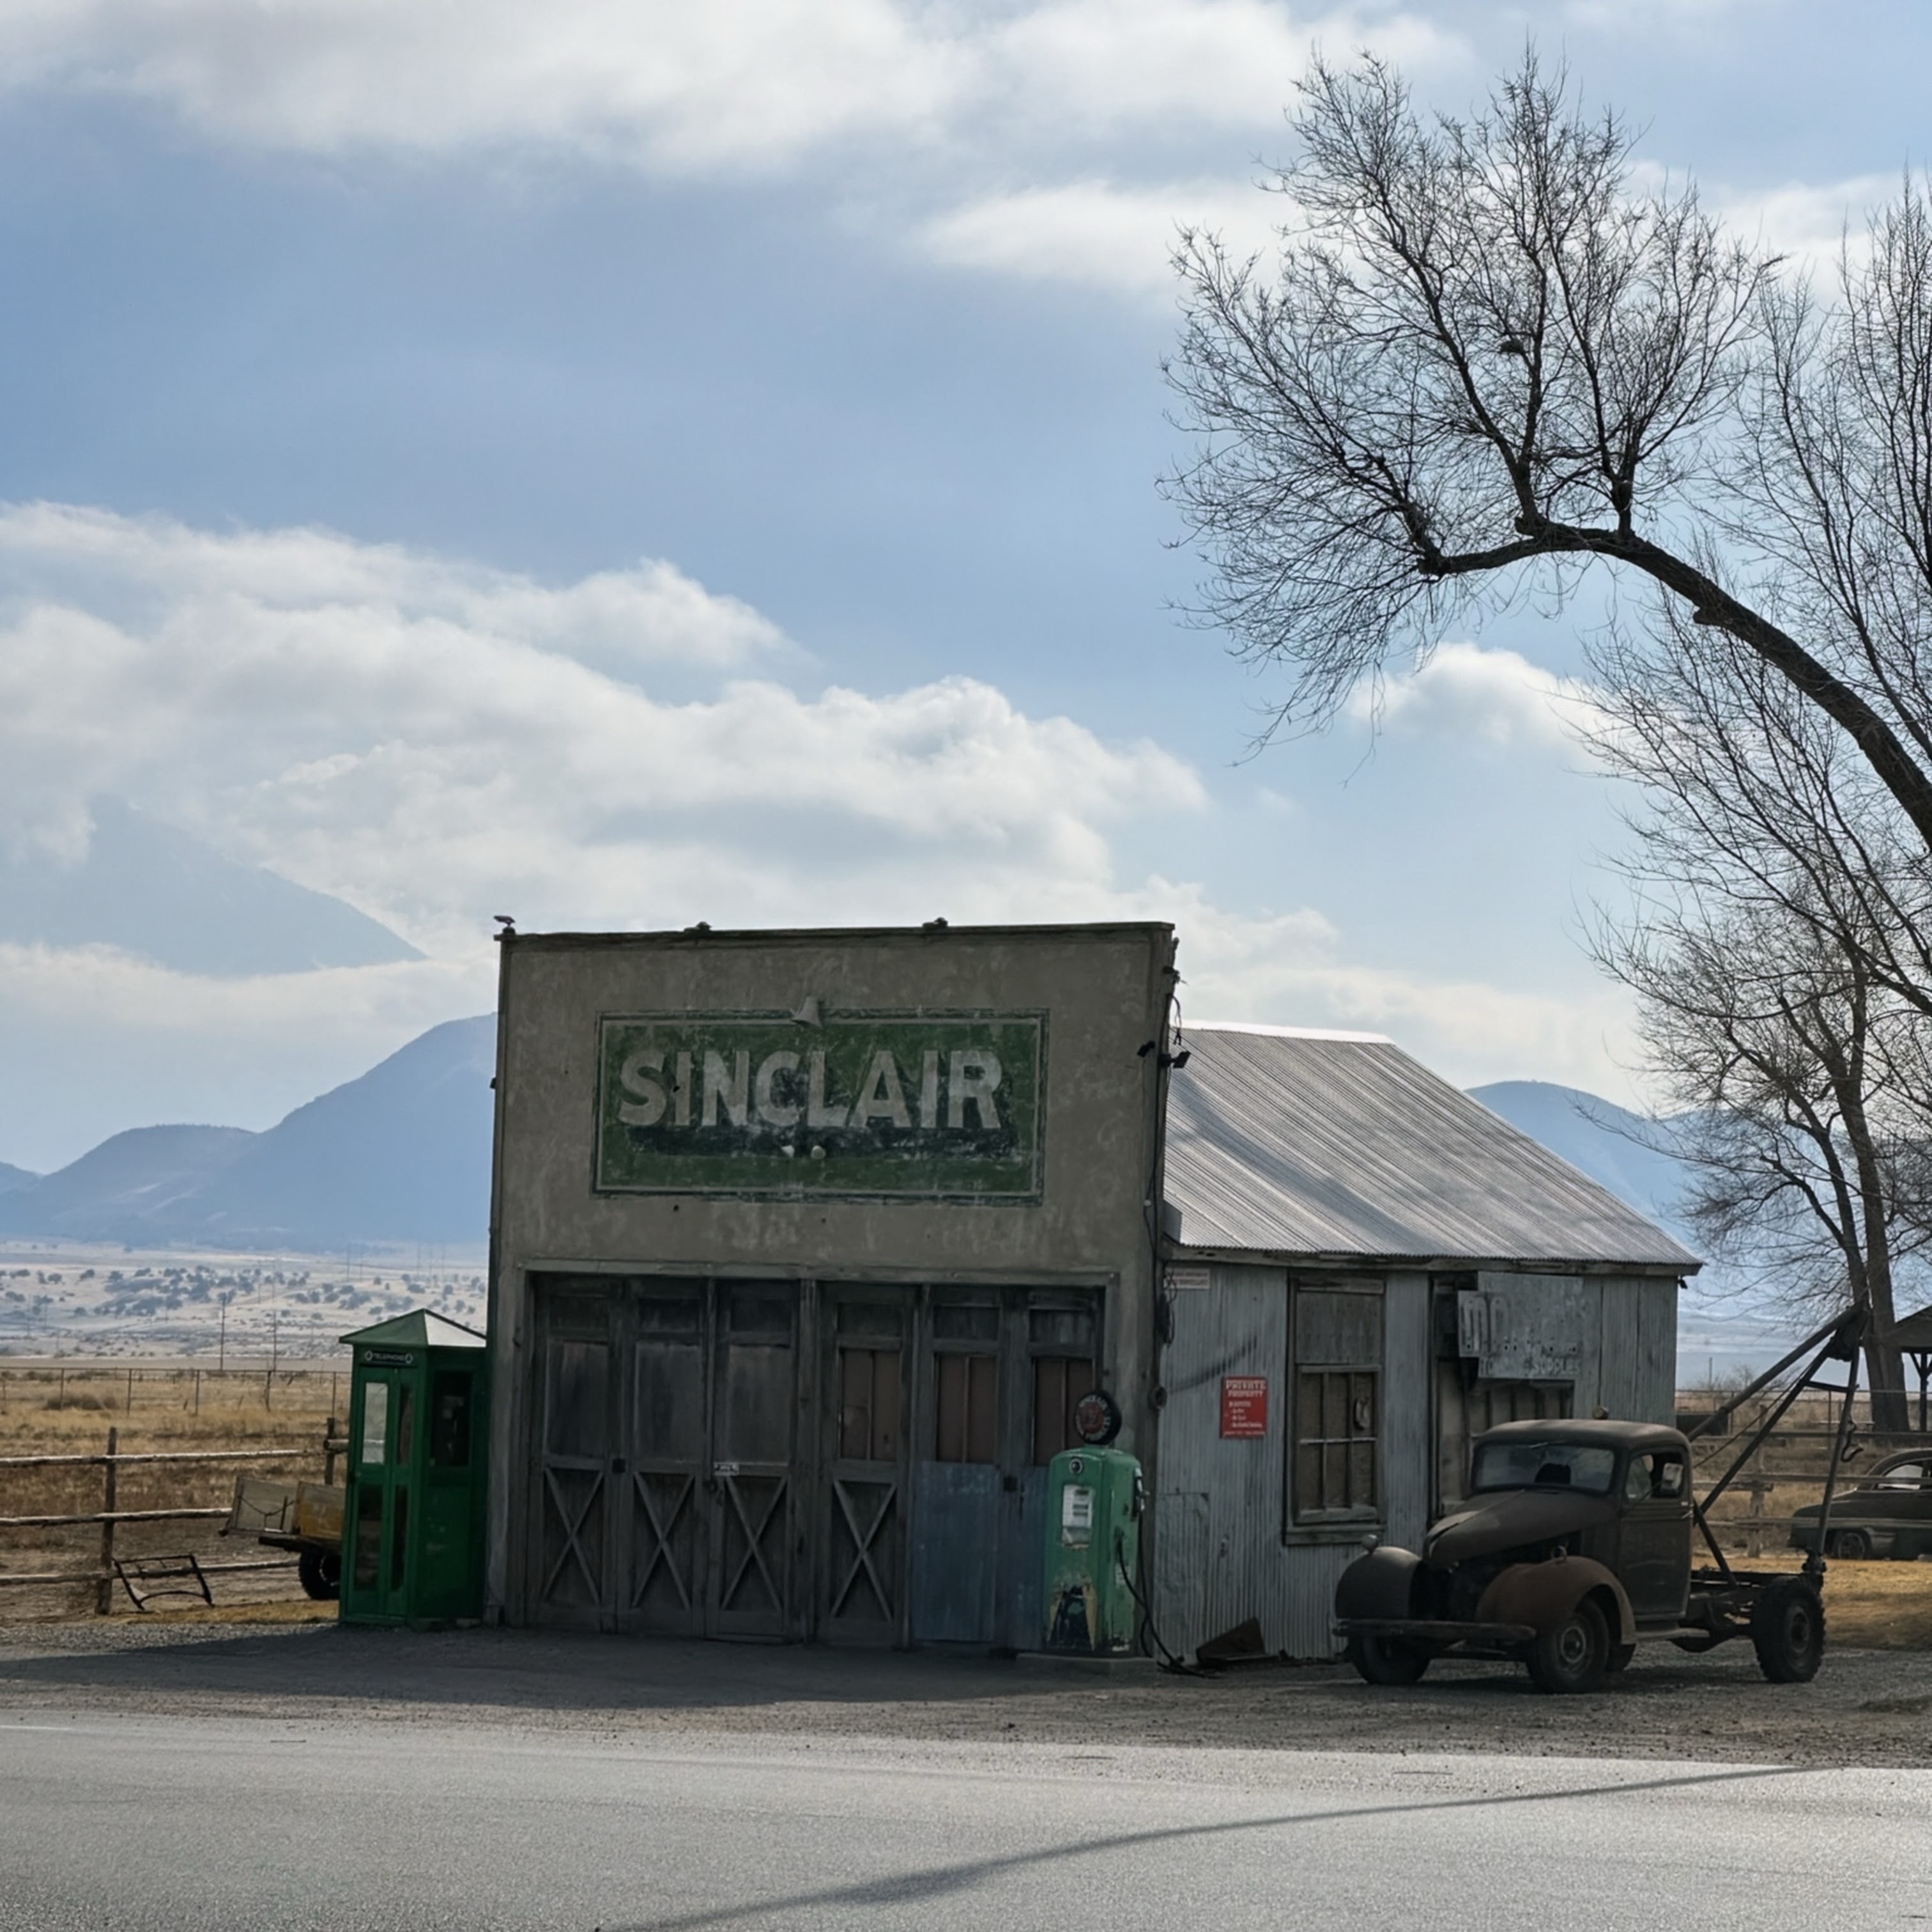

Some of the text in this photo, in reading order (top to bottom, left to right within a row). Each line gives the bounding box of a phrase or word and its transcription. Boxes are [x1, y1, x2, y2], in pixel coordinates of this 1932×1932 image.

[617, 1050, 1002, 1129] SINCLAIR
[373, 1353, 404, 1361] TELEPHONE
[1226, 1380, 1266, 1390] PRIVATE
